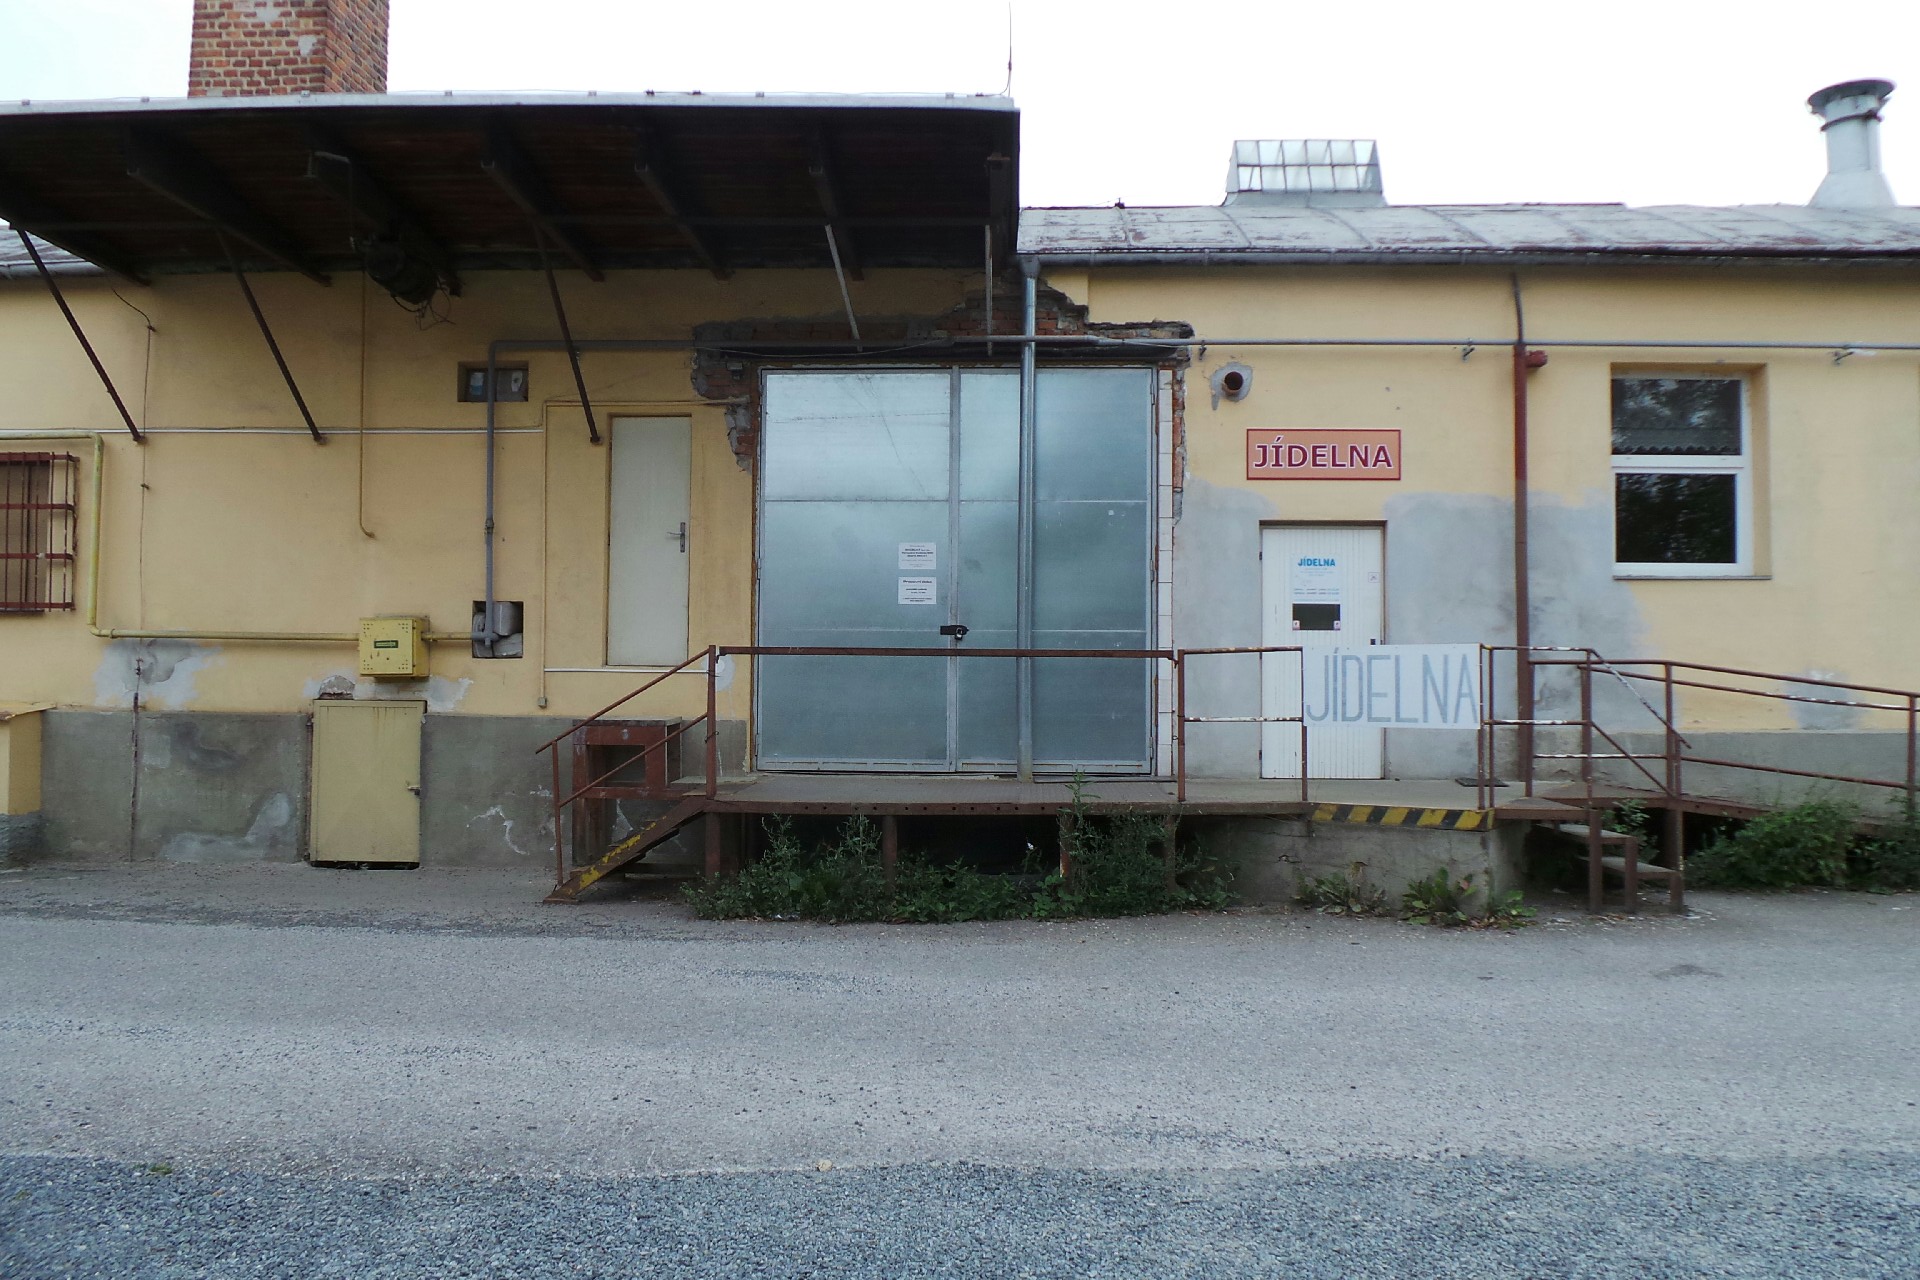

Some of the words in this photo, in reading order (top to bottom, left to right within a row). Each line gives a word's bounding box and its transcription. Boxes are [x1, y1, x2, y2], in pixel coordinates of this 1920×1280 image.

[1254, 435, 1393, 468] JÍDELNA
[1297, 556, 1336, 567] JÍDELNA
[1306, 647, 1478, 723] JÍDELNA
